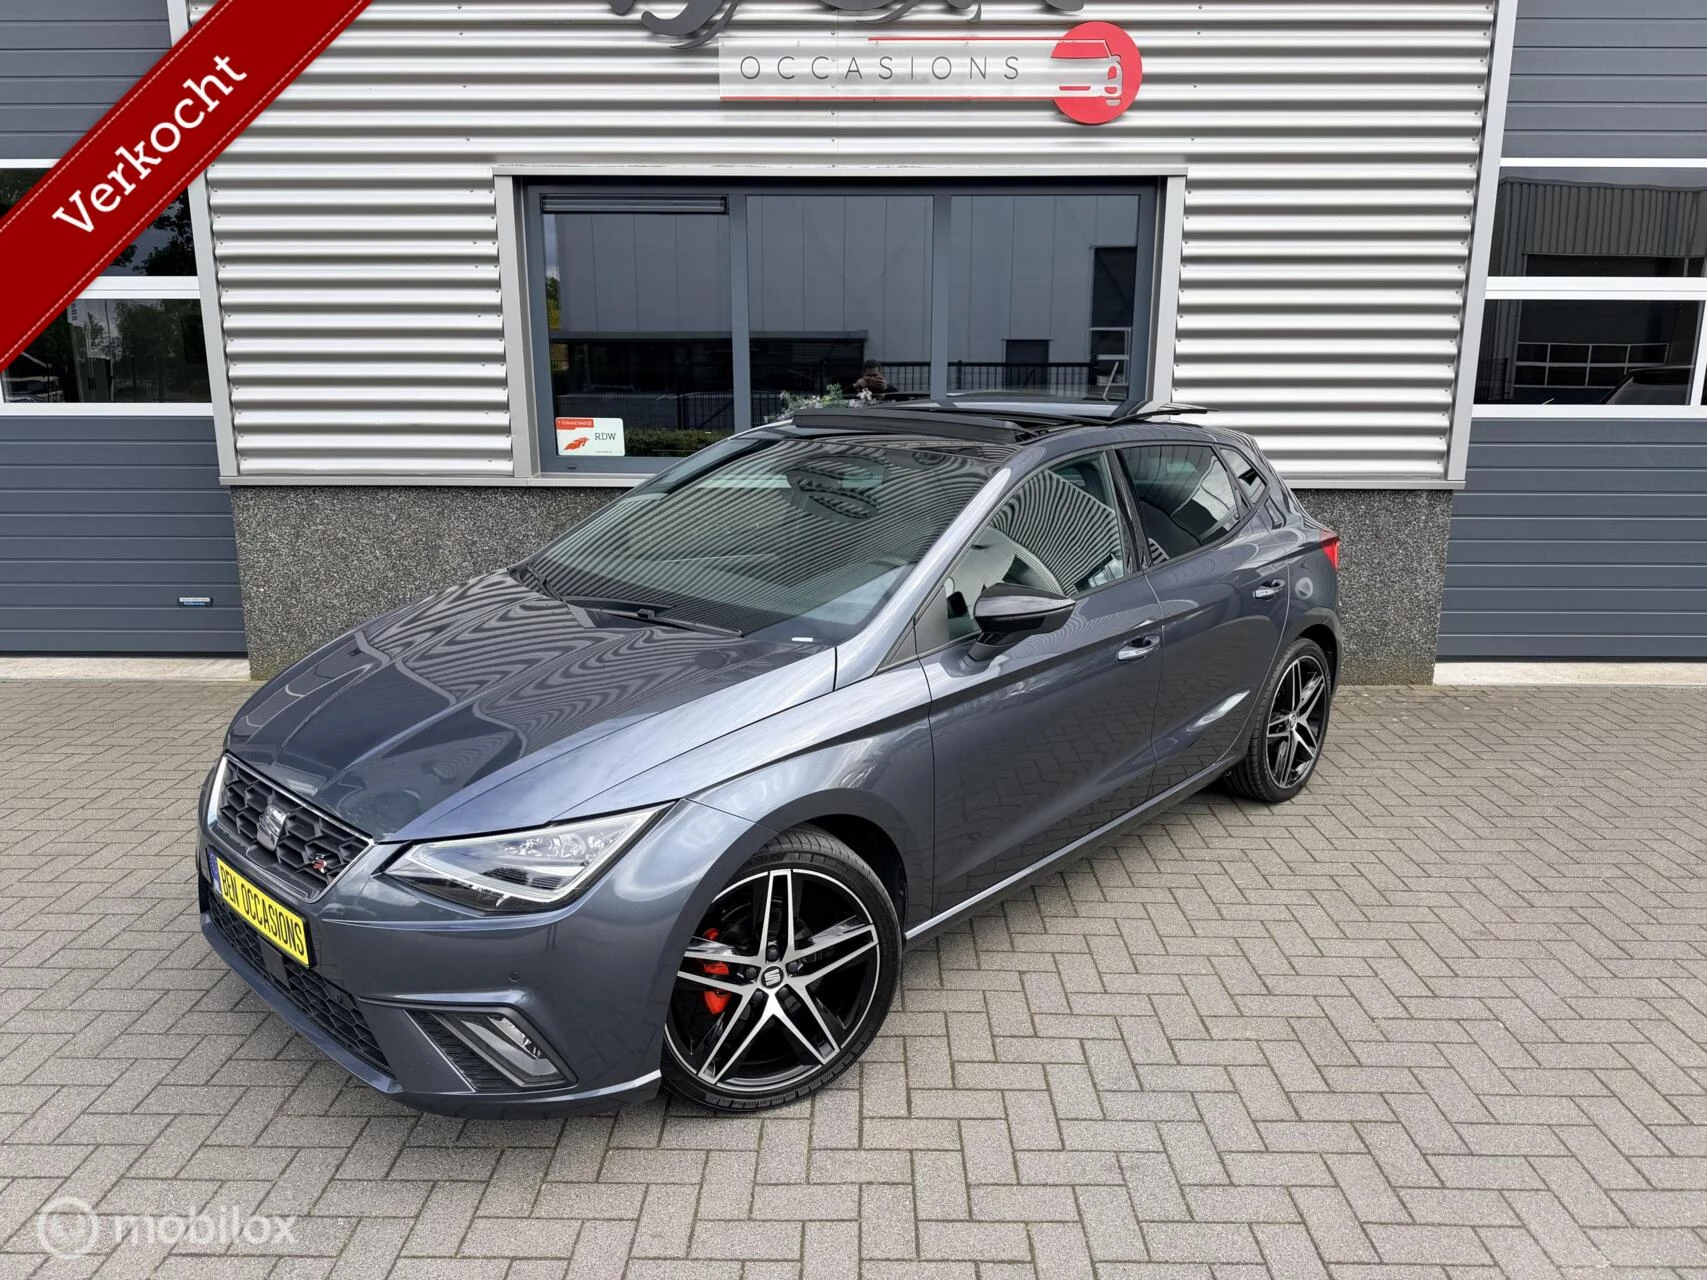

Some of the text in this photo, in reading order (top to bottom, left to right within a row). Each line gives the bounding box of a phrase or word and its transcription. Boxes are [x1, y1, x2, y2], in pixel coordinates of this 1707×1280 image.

[739, 56, 1021, 80] OCCASIONS
[594, 432, 617, 441] RDW
[219, 863, 305, 957] BEN OCCASIONS
